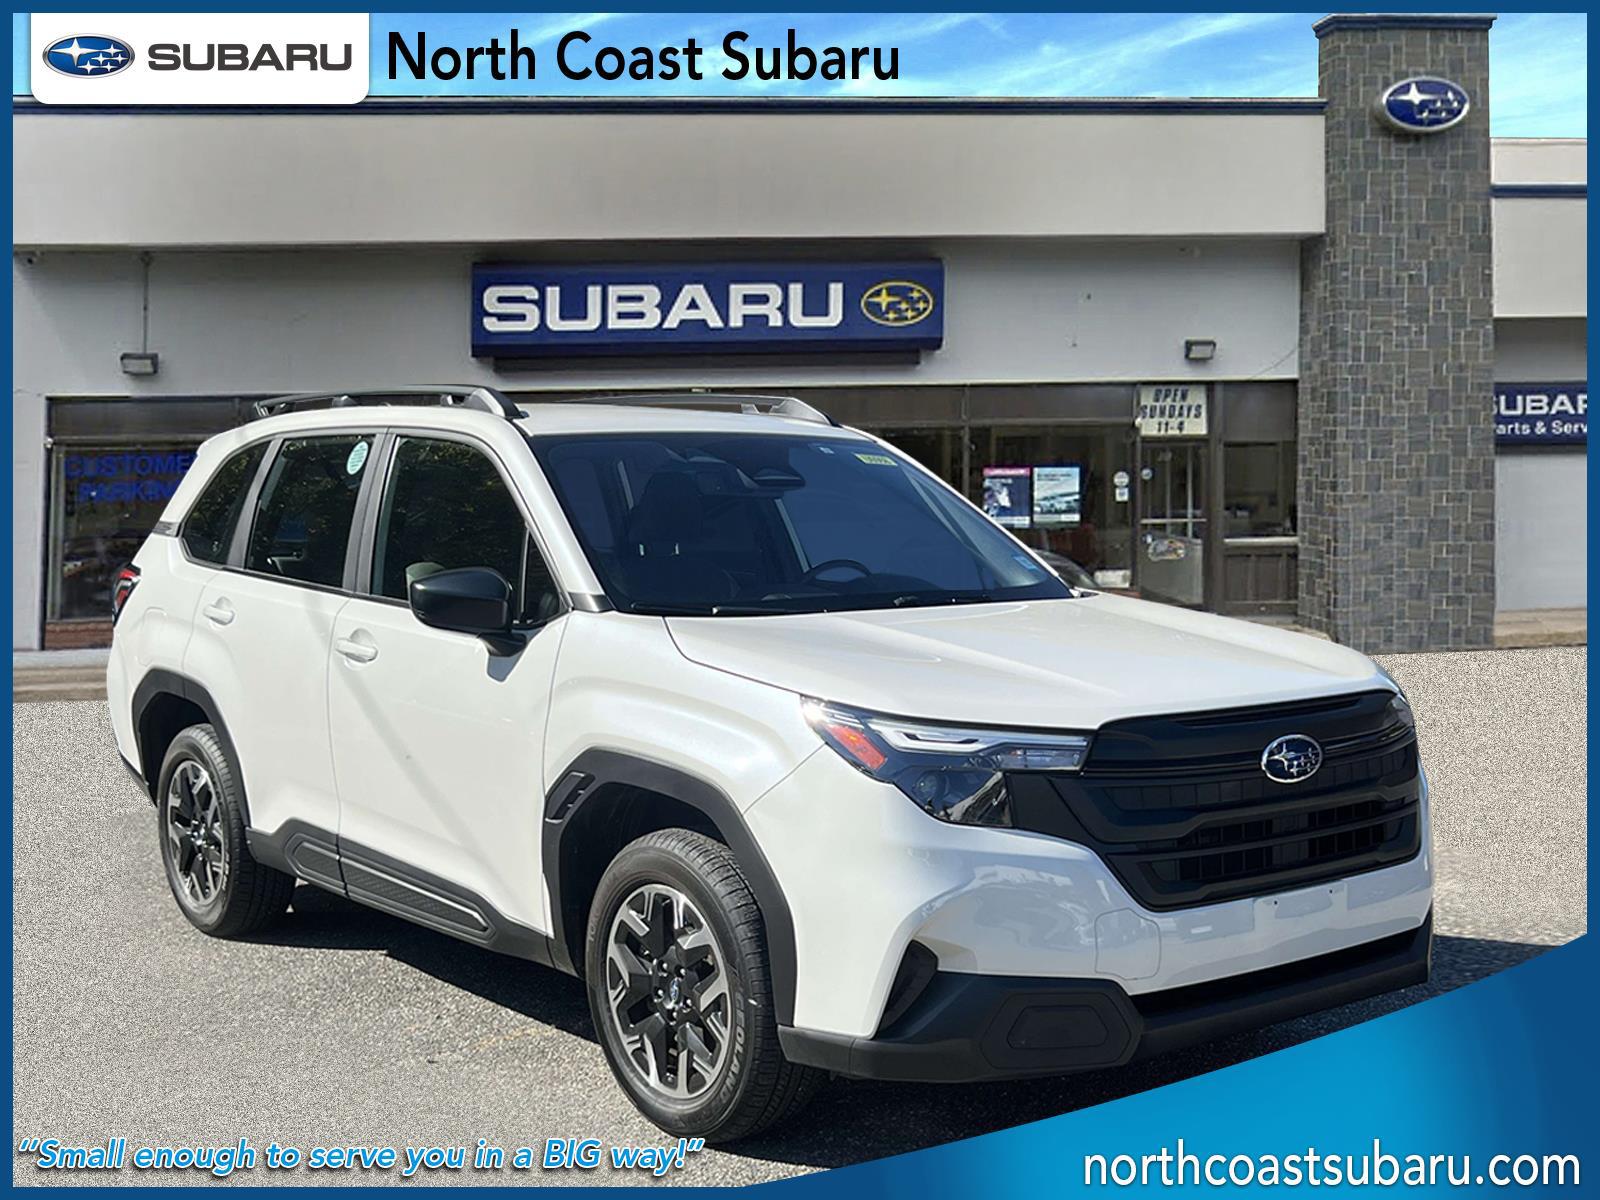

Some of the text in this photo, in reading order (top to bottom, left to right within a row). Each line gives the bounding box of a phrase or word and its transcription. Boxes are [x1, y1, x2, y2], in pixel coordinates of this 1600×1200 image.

[483, 282, 843, 332] SUBARU
[1152, 388, 1189, 403] OPEN
[1139, 404, 1202, 419] SUNDAYS
[1493, 393, 1587, 416] UBA
[1157, 420, 1185, 433] 11-4
[1535, 420, 1547, 435] &
[65, 453, 193, 480] CUSTOME
